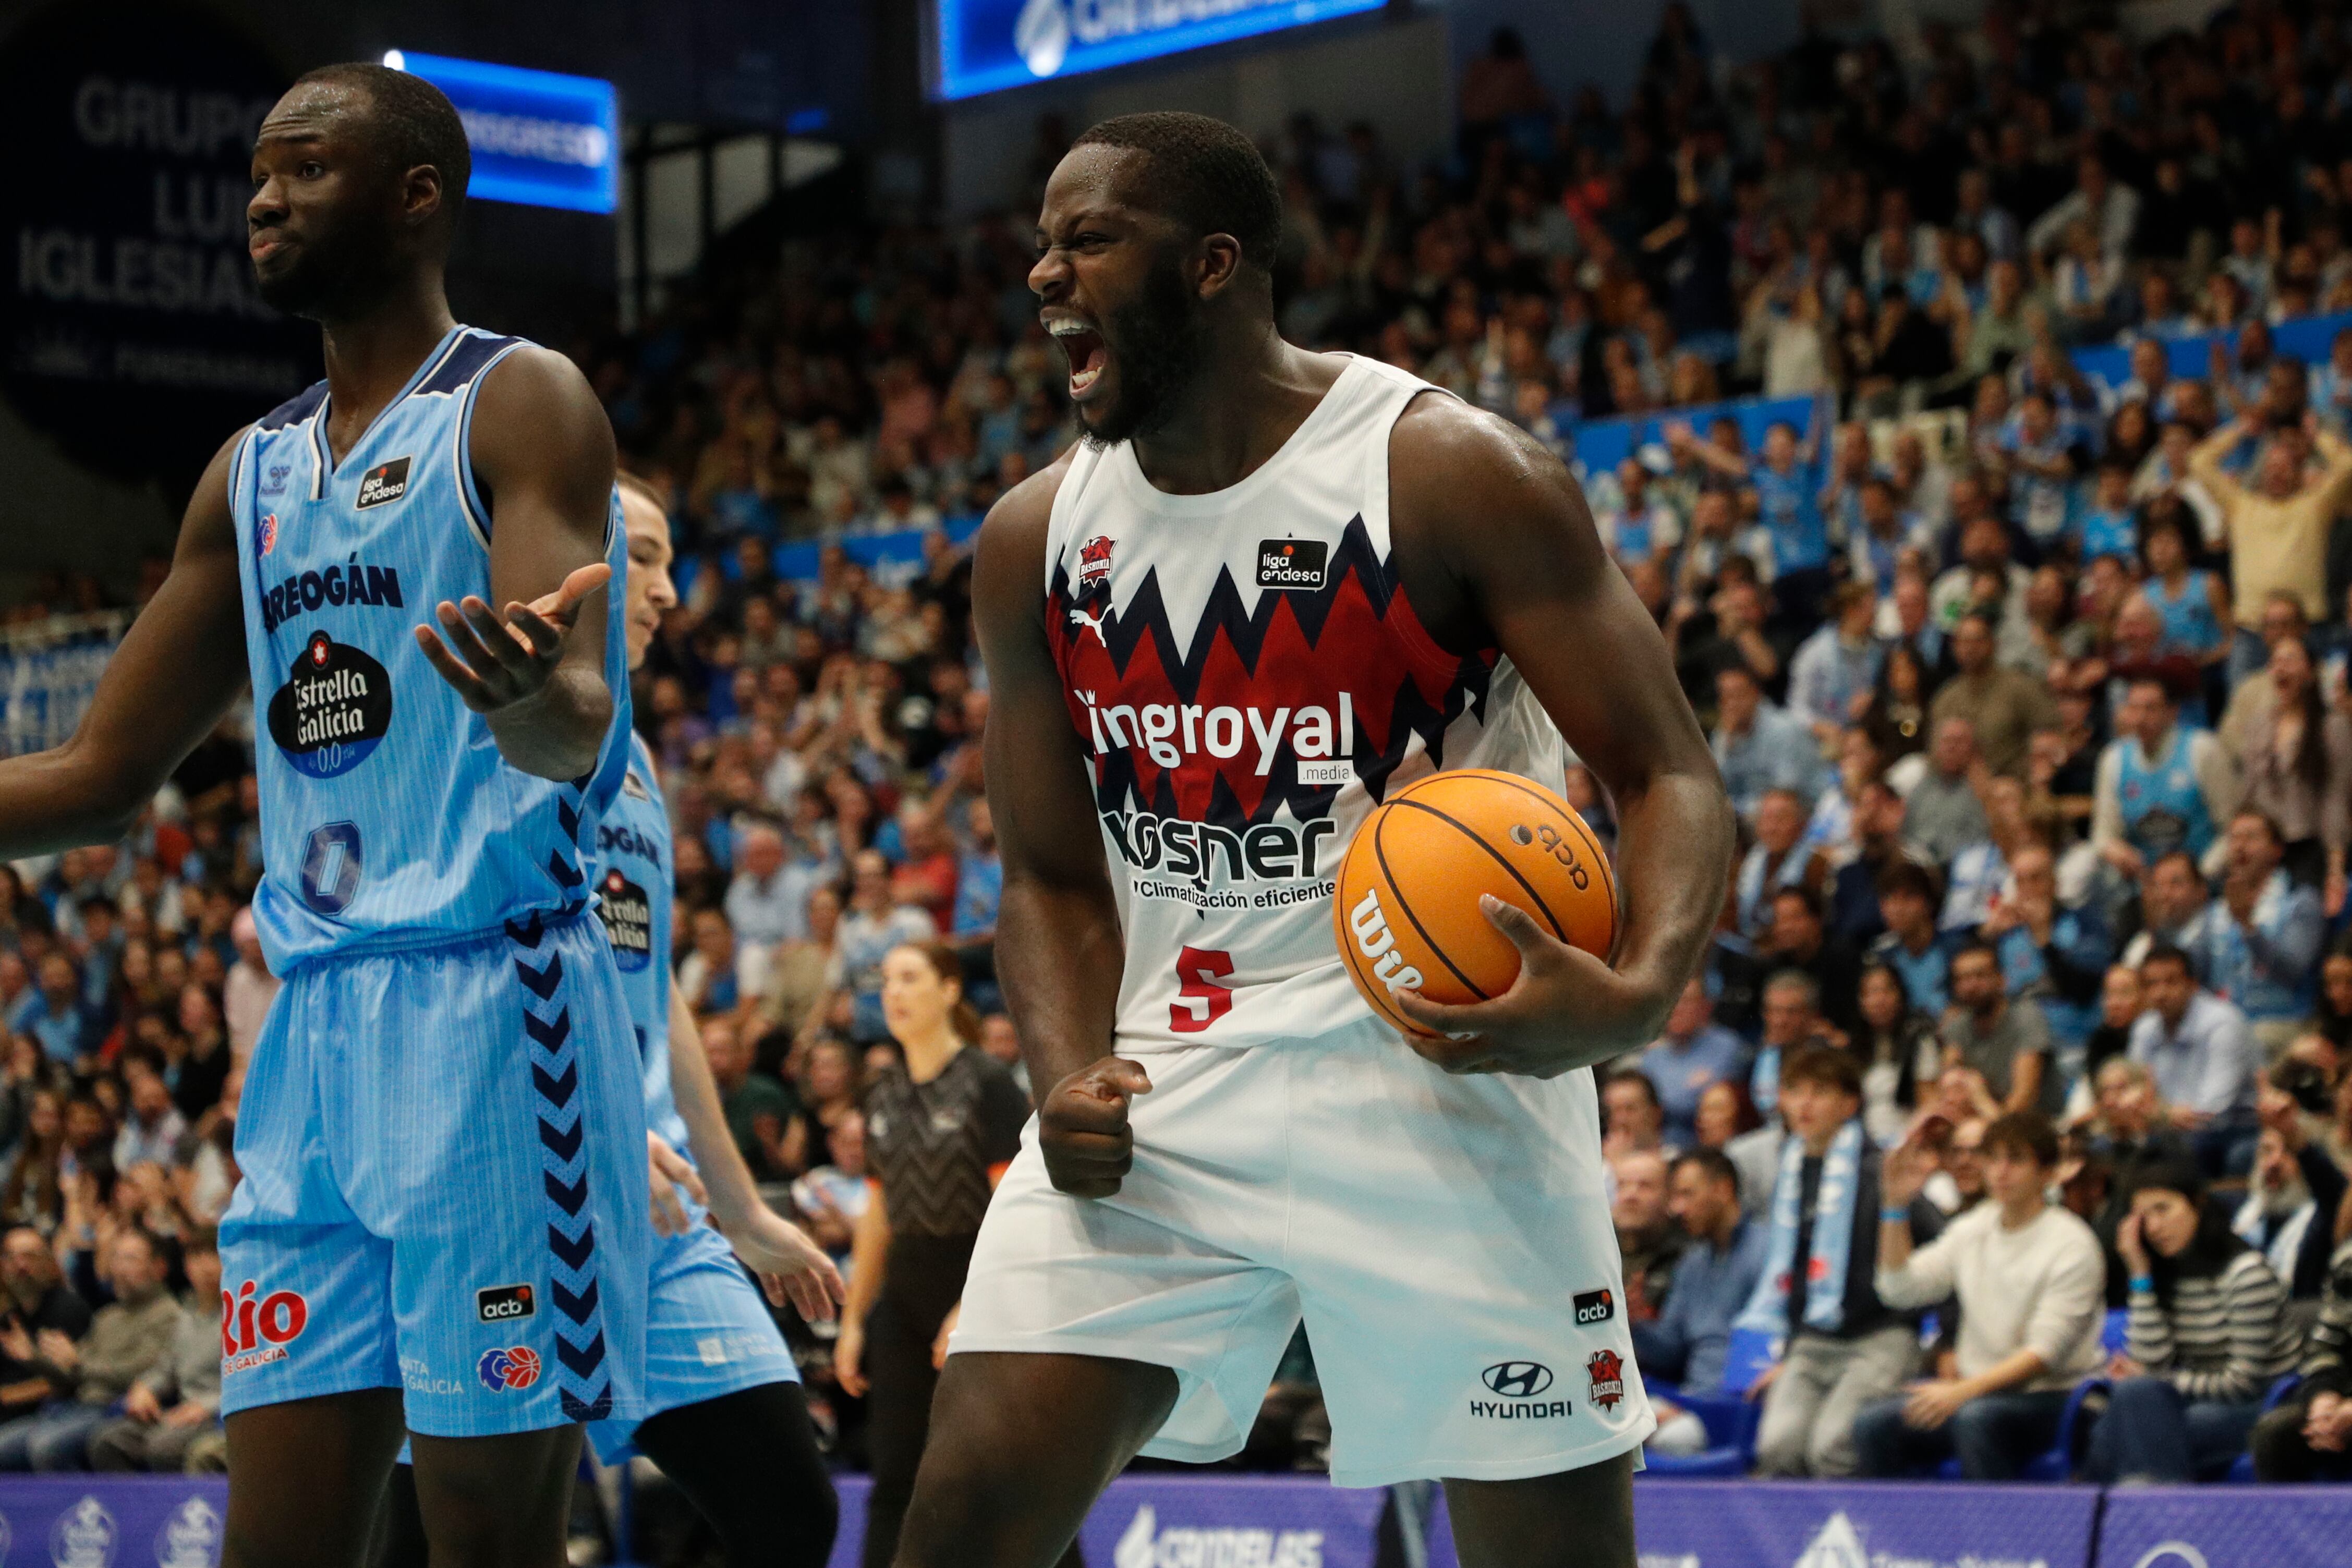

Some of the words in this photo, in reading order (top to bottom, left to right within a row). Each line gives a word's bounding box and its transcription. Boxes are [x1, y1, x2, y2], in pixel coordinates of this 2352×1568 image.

[361, 482, 404, 504] endesa
[364, 477, 383, 492] liga
[1263, 554, 1289, 568] liga
[1261, 569, 1320, 582] endesa
[297, 702, 365, 745] Galicia
[317, 741, 341, 772] 0,0
[1303, 767, 1350, 781] .media
[300, 820, 362, 915] 0
[1536, 824, 1590, 891] acb
[1140, 880, 1248, 908] Climatización
[1254, 881, 1336, 908] eficiente
[1169, 945, 1234, 1032] 5
[483, 1299, 522, 1318] acb
[1578, 1302, 1607, 1322] acb
[236, 1348, 288, 1370] GALICIA
[408, 1375, 464, 1394] GALICIA
[1470, 1400, 1572, 1419] HYUNDAI
